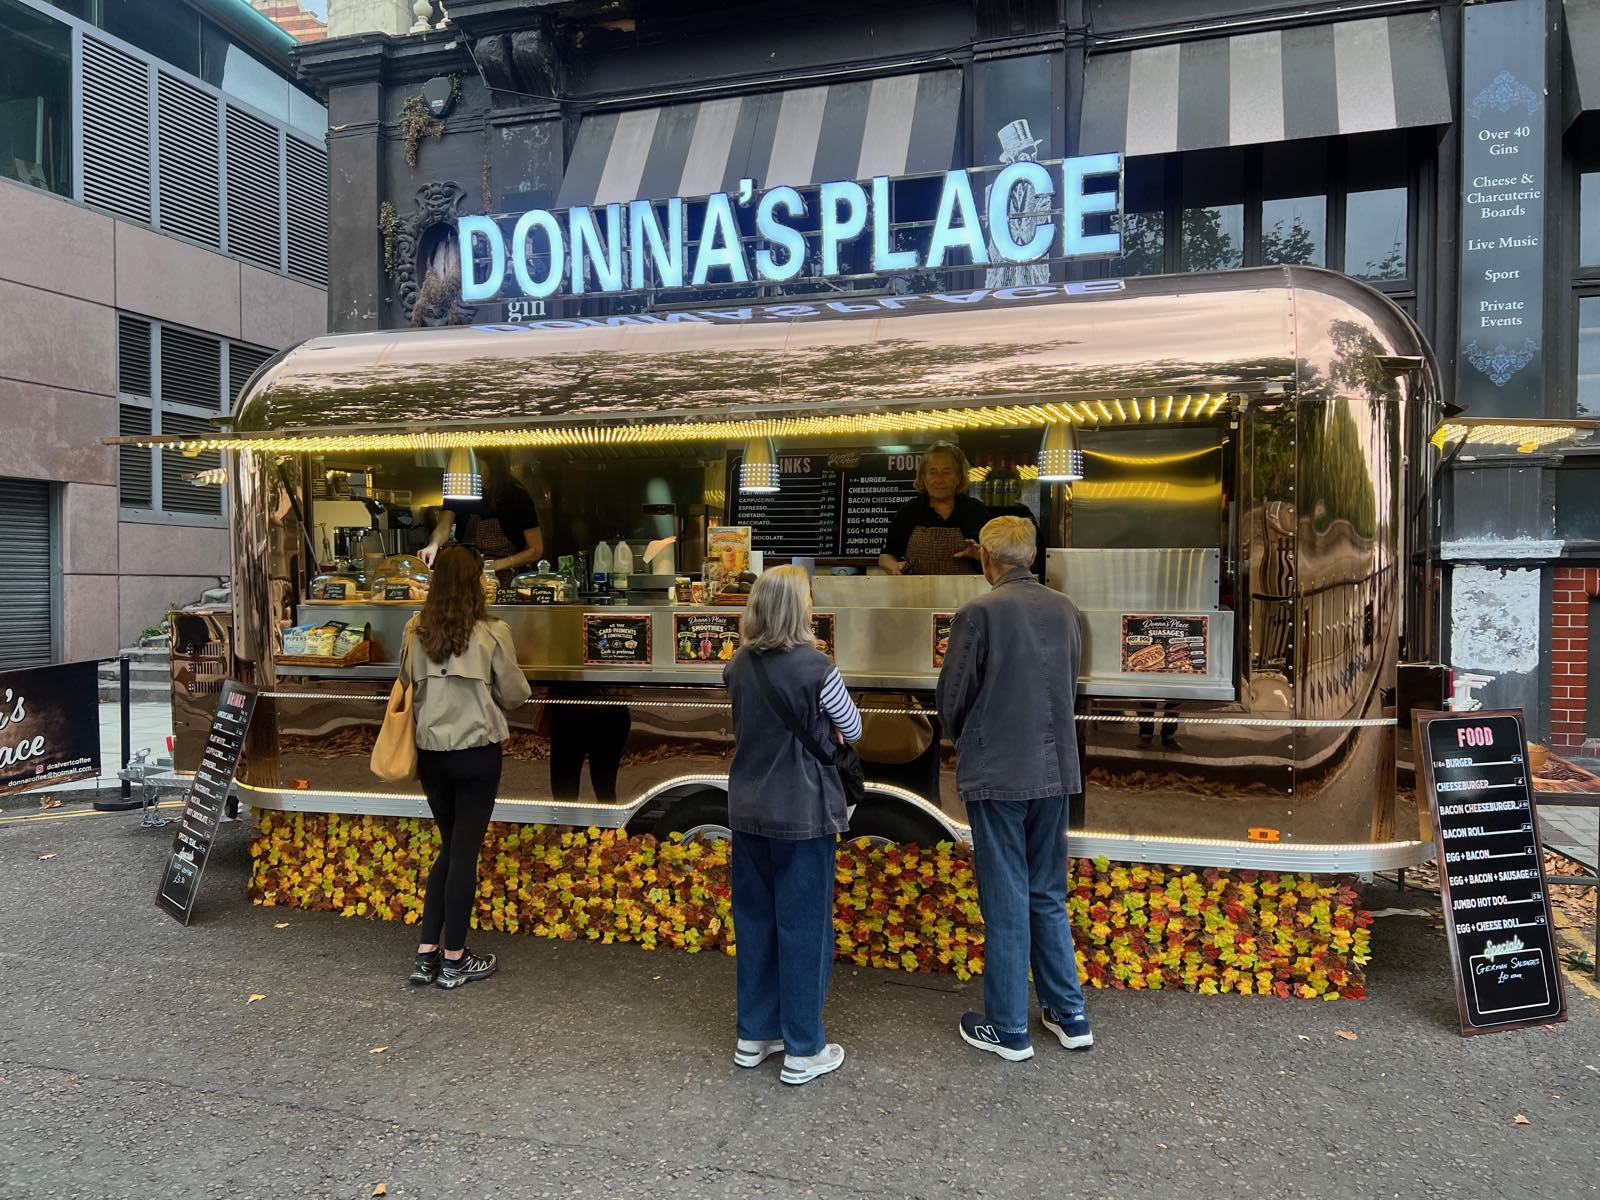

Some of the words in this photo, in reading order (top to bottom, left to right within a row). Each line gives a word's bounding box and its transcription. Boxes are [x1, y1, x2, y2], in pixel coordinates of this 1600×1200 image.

[1479, 130, 1510, 140] Over
[1514, 126, 1530, 137] 40
[1490, 144, 1519, 155] Gins
[1474, 176, 1517, 187] Cheese
[1521, 173, 1535, 183] &
[1467, 188, 1541, 204] Charcuterie
[1481, 205, 1525, 218] Boards
[1468, 239, 1495, 250] Live
[1499, 235, 1538, 248] Music
[1485, 270, 1520, 282] Sport
[1480, 300, 1524, 311] Private
[1481, 316, 1522, 327] Events
[1143, 620, 1169, 628] Donna's
[1170, 620, 1190, 628] Place
[613, 628, 636, 636] PAYMENTS
[1457, 727, 1493, 748] FOOD
[1445, 758, 1473, 769] BURGER
[1436, 780, 1489, 792] CHEESEBURGER
[1440, 804, 1464, 816] BACON
[1464, 801, 1516, 814] CHEESEBURGER
[1442, 828, 1467, 839] BACON
[1467, 826, 1484, 836] ROLL
[1446, 852, 1460, 863] EGG
[1466, 850, 1489, 861] BACON
[1449, 876, 1464, 886] EGG
[1469, 873, 1494, 885] BACON
[1498, 870, 1530, 881] SAUSAGE
[1453, 899, 1476, 910] JUMBO
[1477, 897, 1492, 908] HOT
[1493, 895, 1508, 906] DOG
[1456, 923, 1471, 934] EGG
[1476, 919, 1502, 932] CHEESE
[1503, 918, 1521, 929] ROLL
[1484, 934, 1524, 963] Specials
